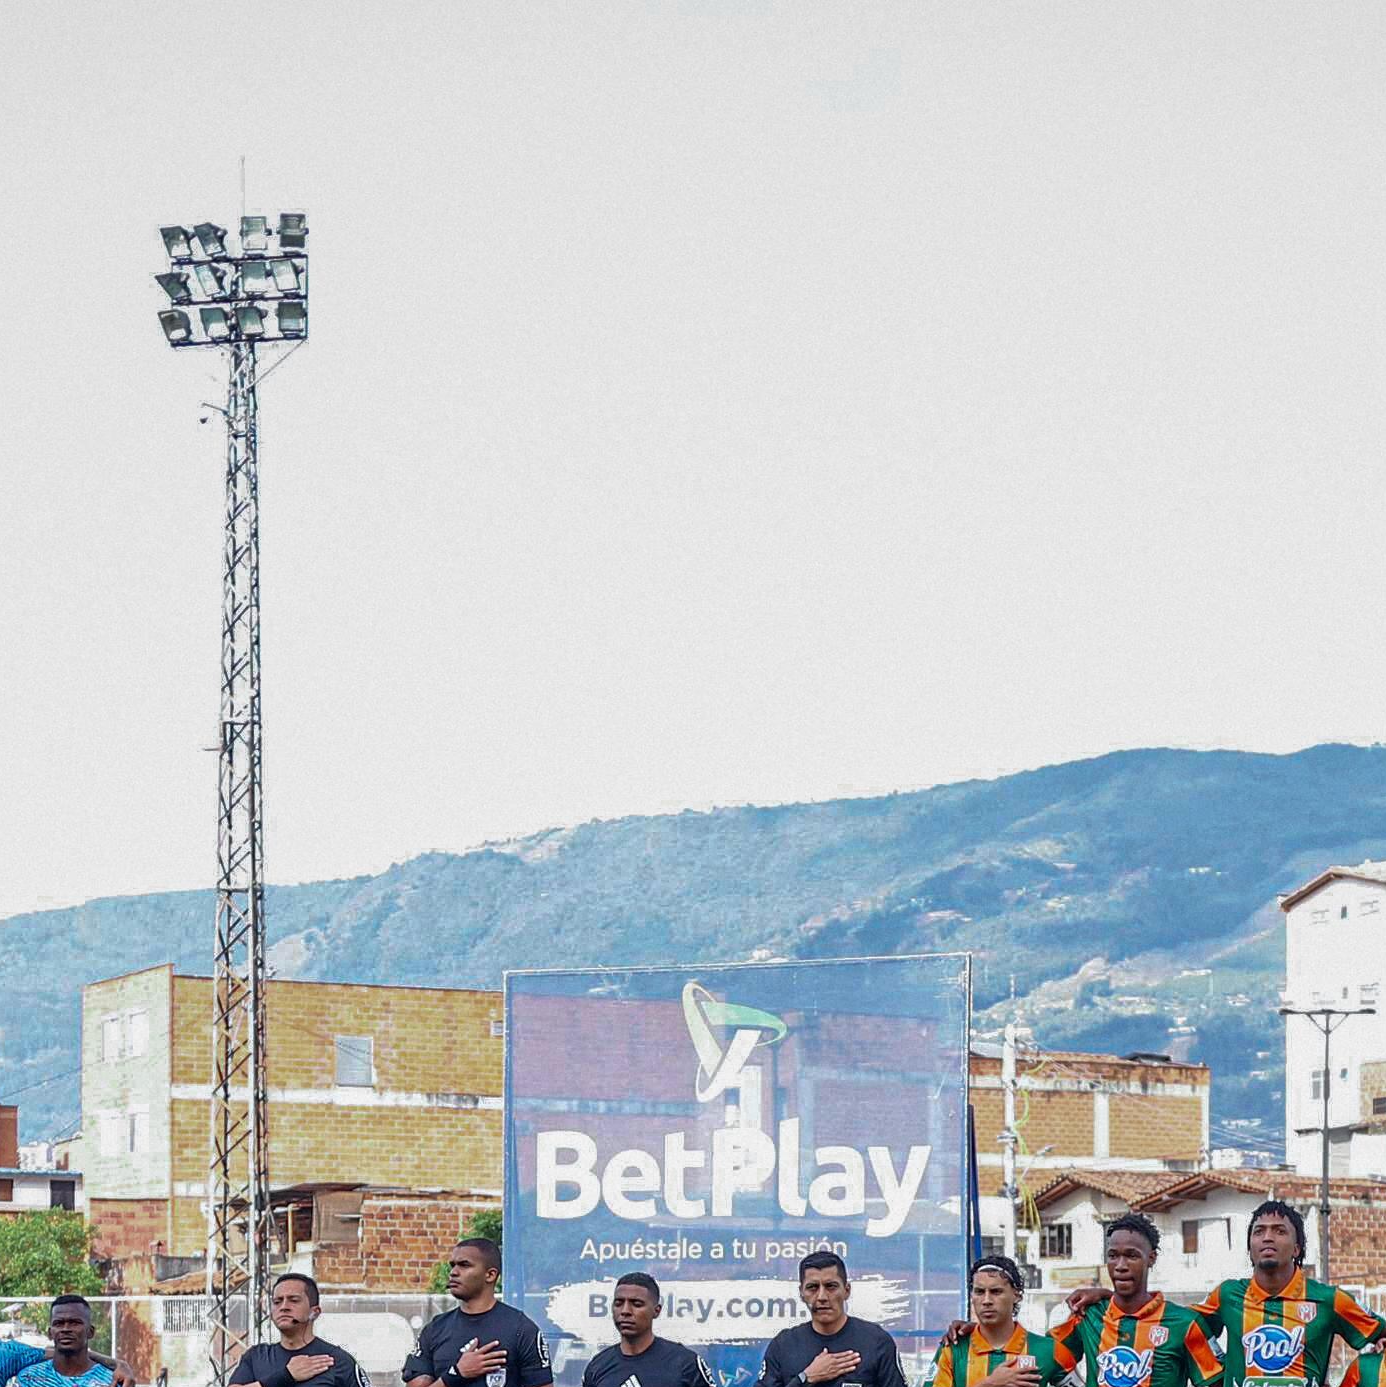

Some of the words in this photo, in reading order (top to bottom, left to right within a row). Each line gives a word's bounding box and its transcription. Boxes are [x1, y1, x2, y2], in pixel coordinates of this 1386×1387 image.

[536, 1118, 932, 1238] BetPlay
[580, 1239, 702, 1262] Apuéstale
[711, 1243, 724, 1258] a
[732, 1240, 758, 1258] tu
[764, 1237, 848, 1262] pasión
[1243, 1326, 1304, 1367] Pool
[1097, 1349, 1154, 1385] Pool
